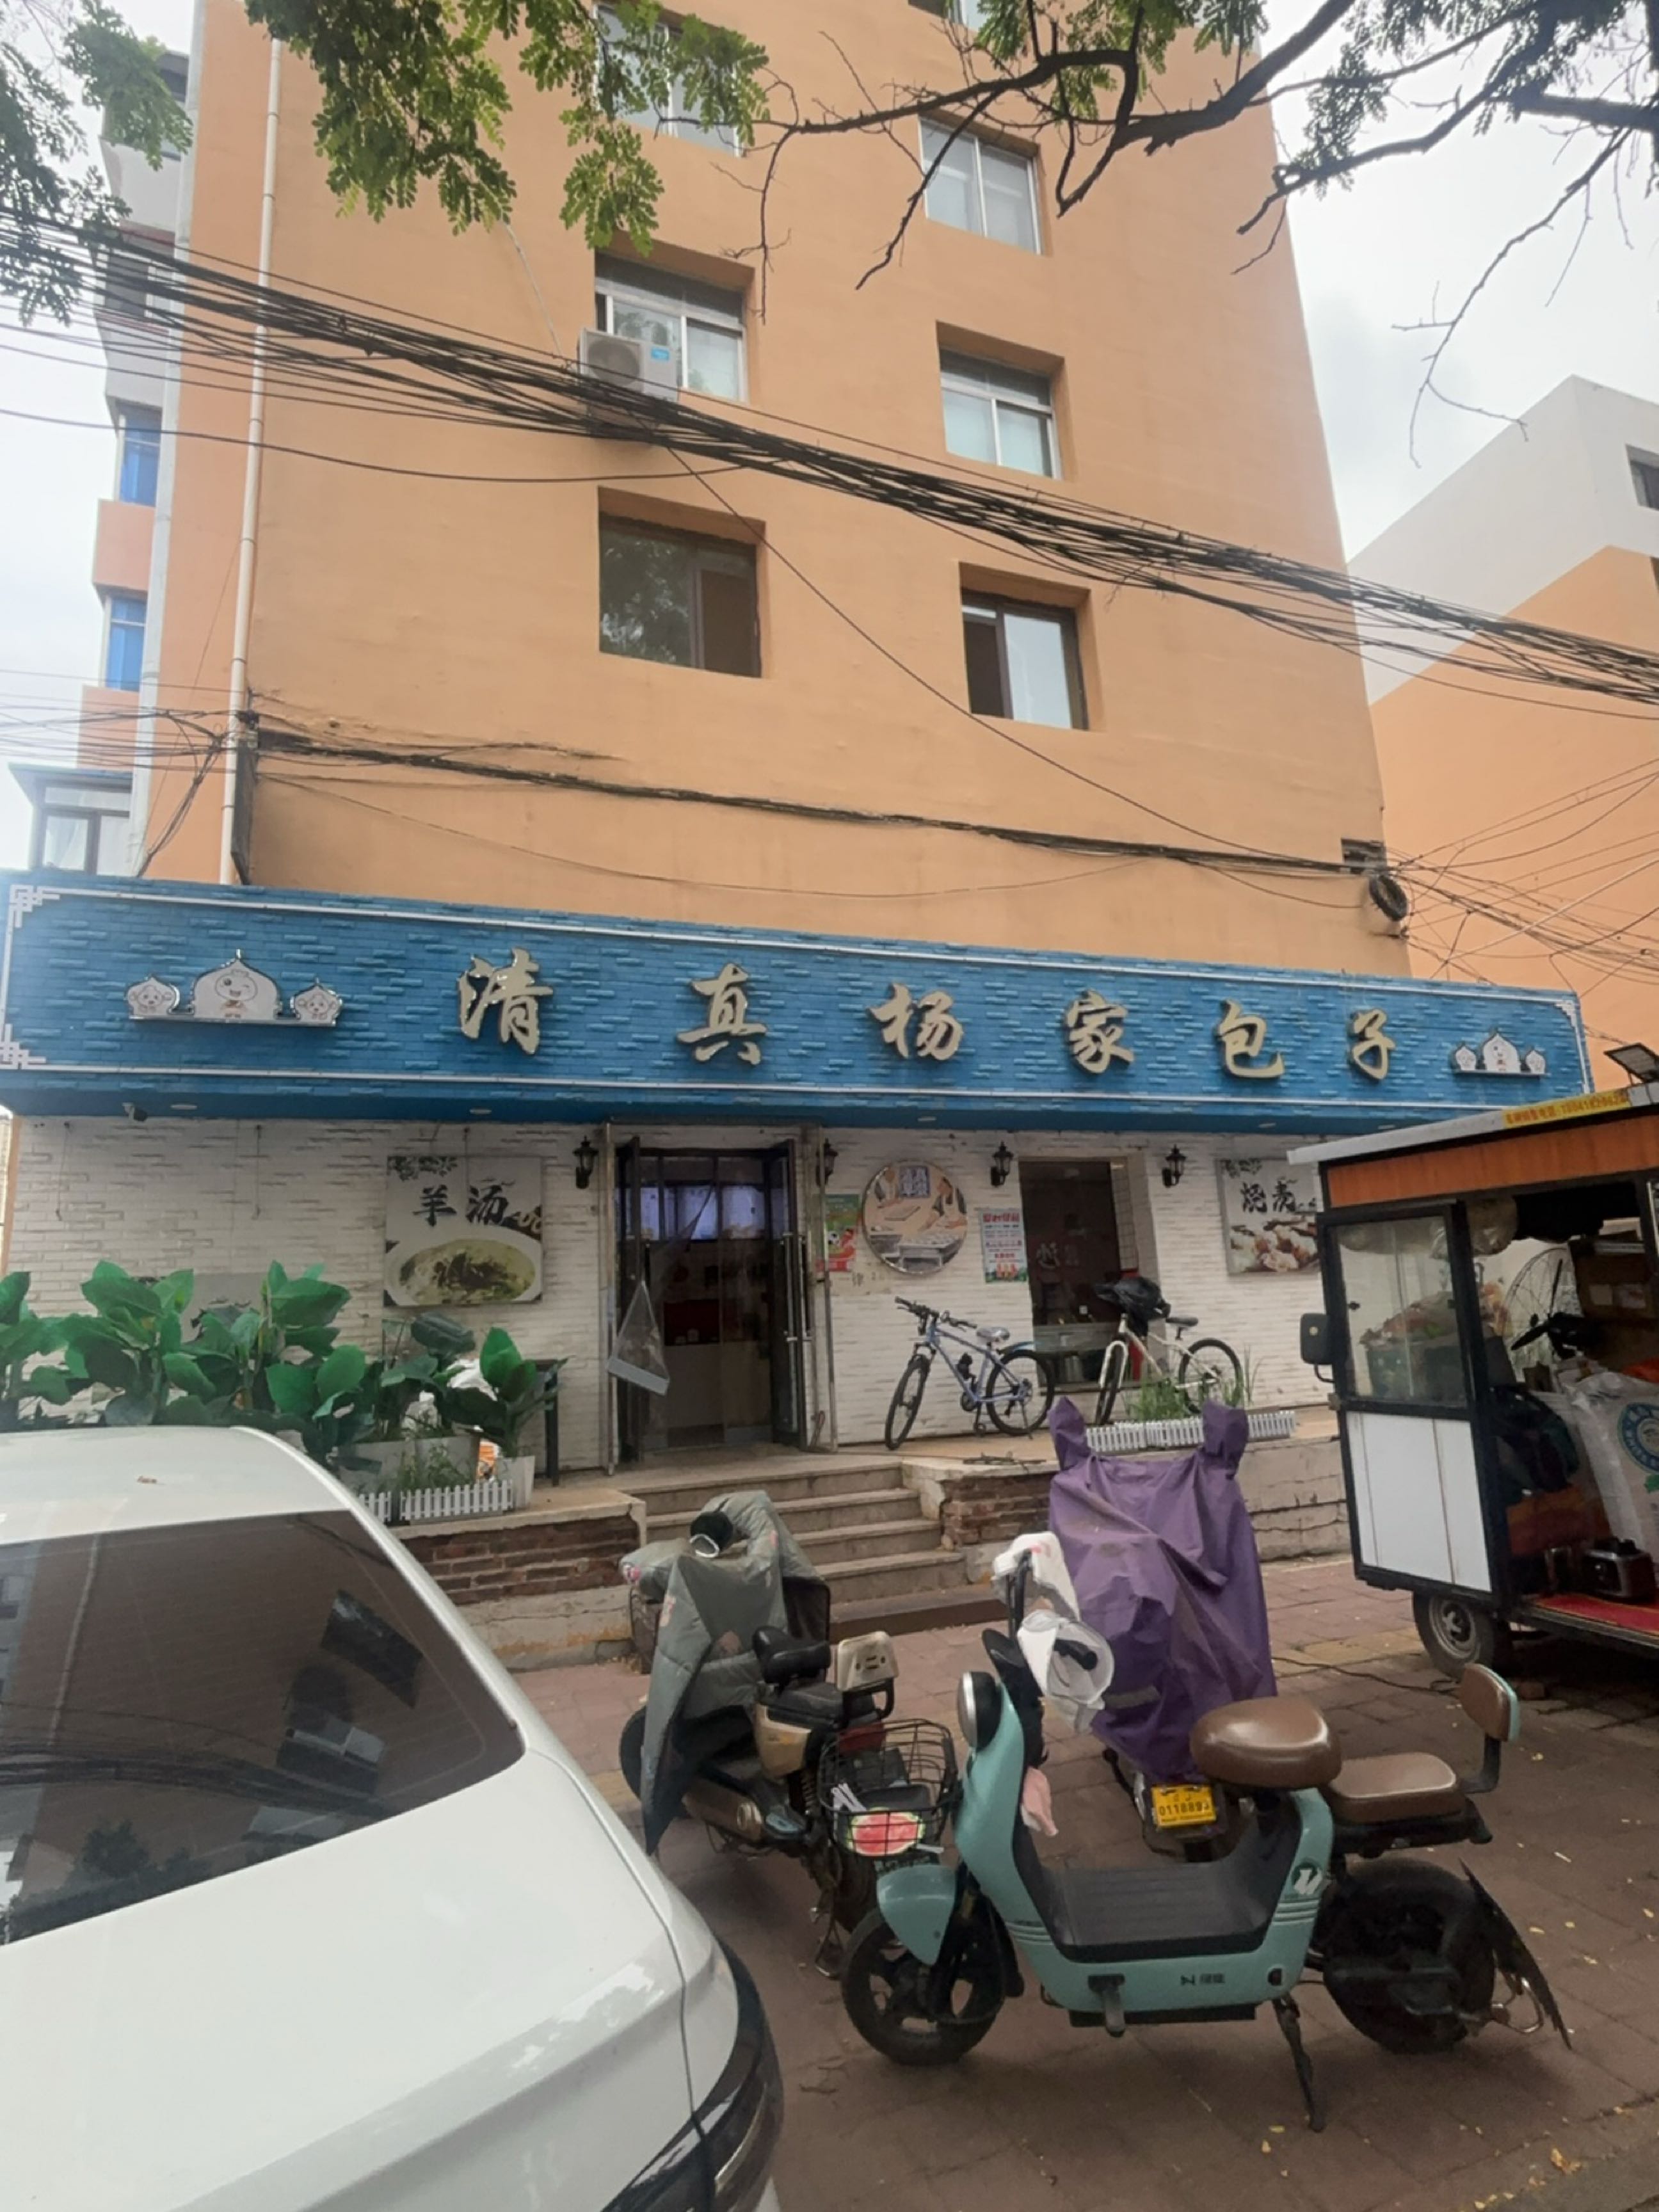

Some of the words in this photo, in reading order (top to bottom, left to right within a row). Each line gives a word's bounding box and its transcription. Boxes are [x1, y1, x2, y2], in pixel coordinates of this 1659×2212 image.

[457, 947, 1397, 1080] 清真杨家包子
[412, 1184, 509, 1226] 羊汤
